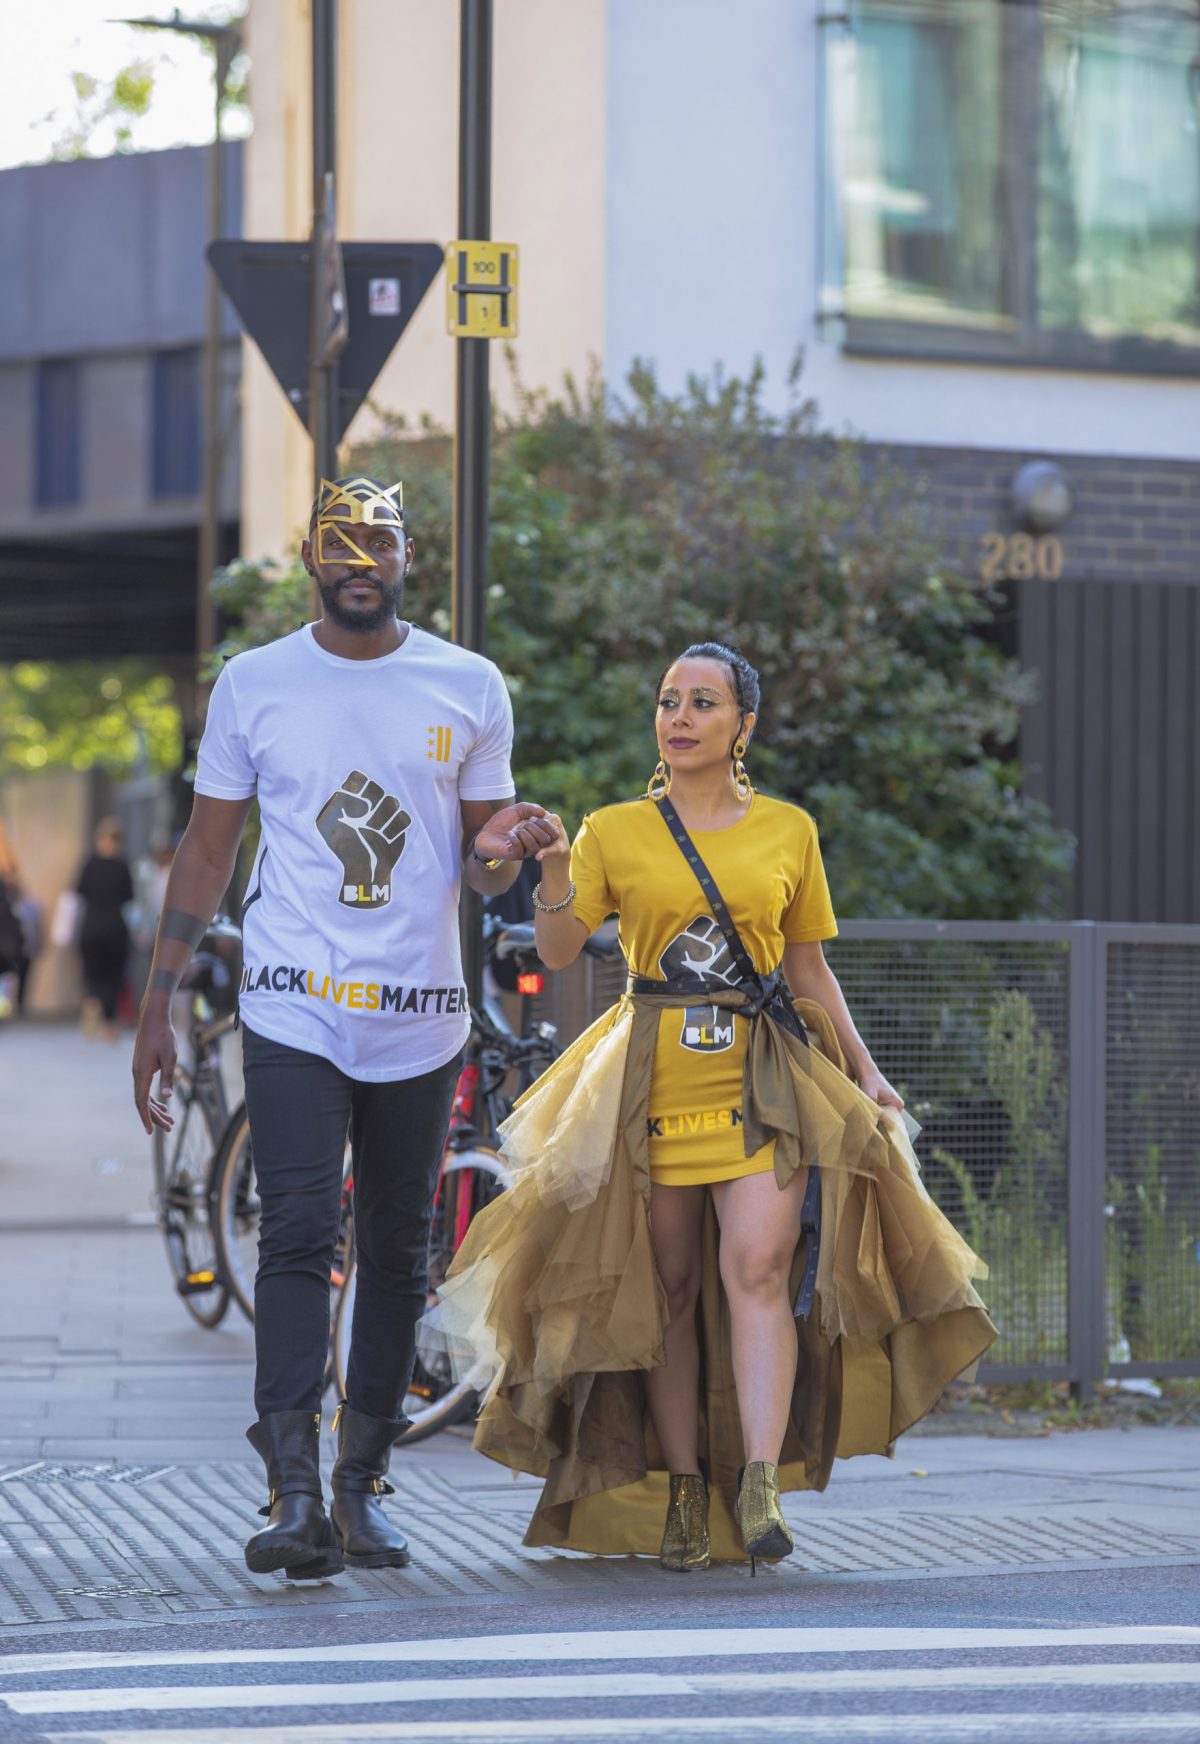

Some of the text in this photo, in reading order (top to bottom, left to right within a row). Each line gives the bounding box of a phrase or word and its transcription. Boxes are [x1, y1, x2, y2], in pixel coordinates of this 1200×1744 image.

[473, 261, 496, 274] 100
[481, 306, 488, 318] 1
[981, 532, 1064, 579] 280
[343, 884, 390, 902] BLM
[685, 1026, 732, 1044] BLM
